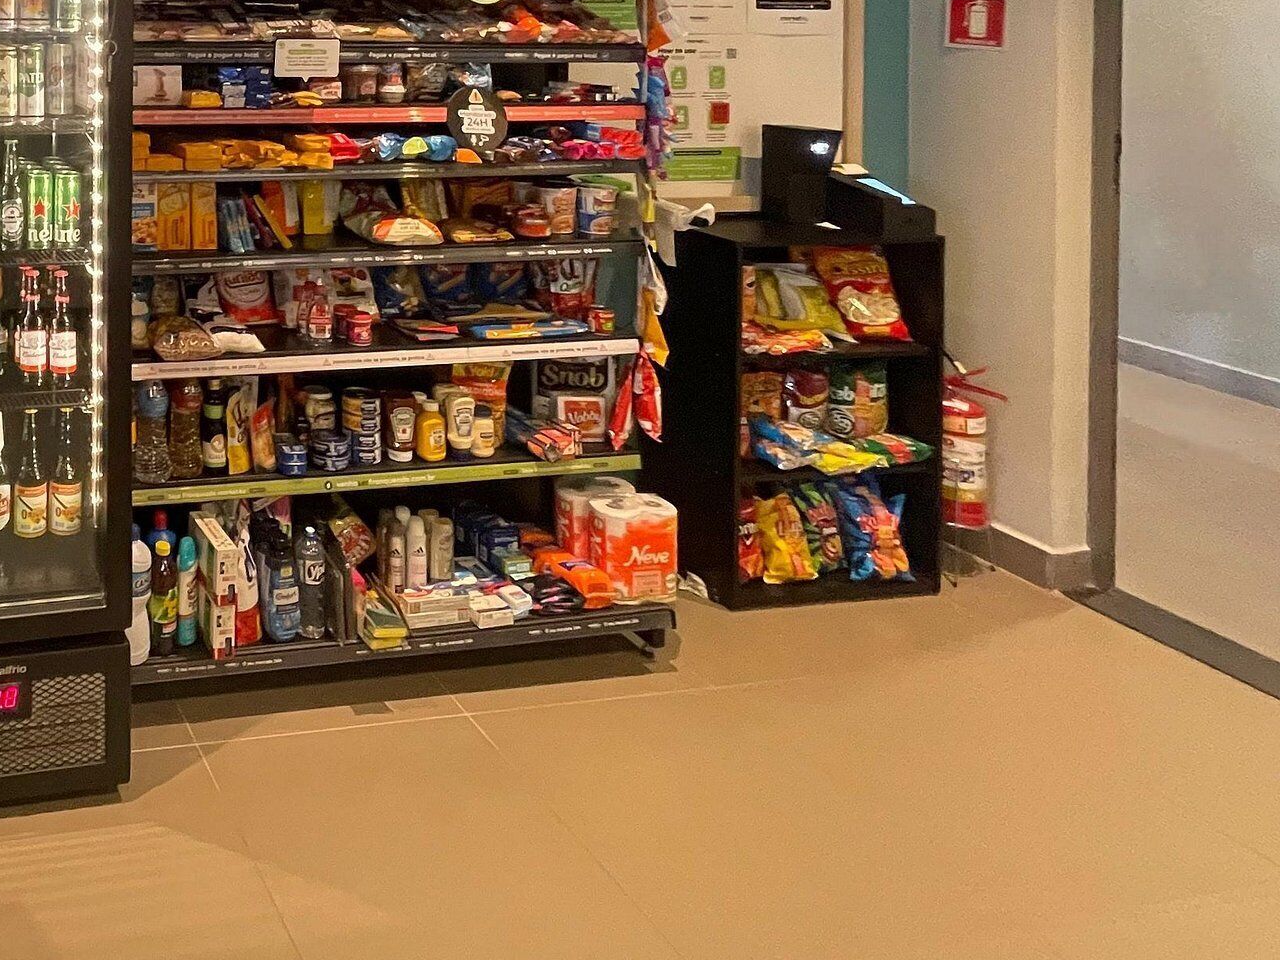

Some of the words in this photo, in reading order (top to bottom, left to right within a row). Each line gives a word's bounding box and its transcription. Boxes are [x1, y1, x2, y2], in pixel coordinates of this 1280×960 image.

[467, 117, 488, 127] 24H
[540, 363, 605, 388] Snob
[623, 547, 670, 567] Neve
